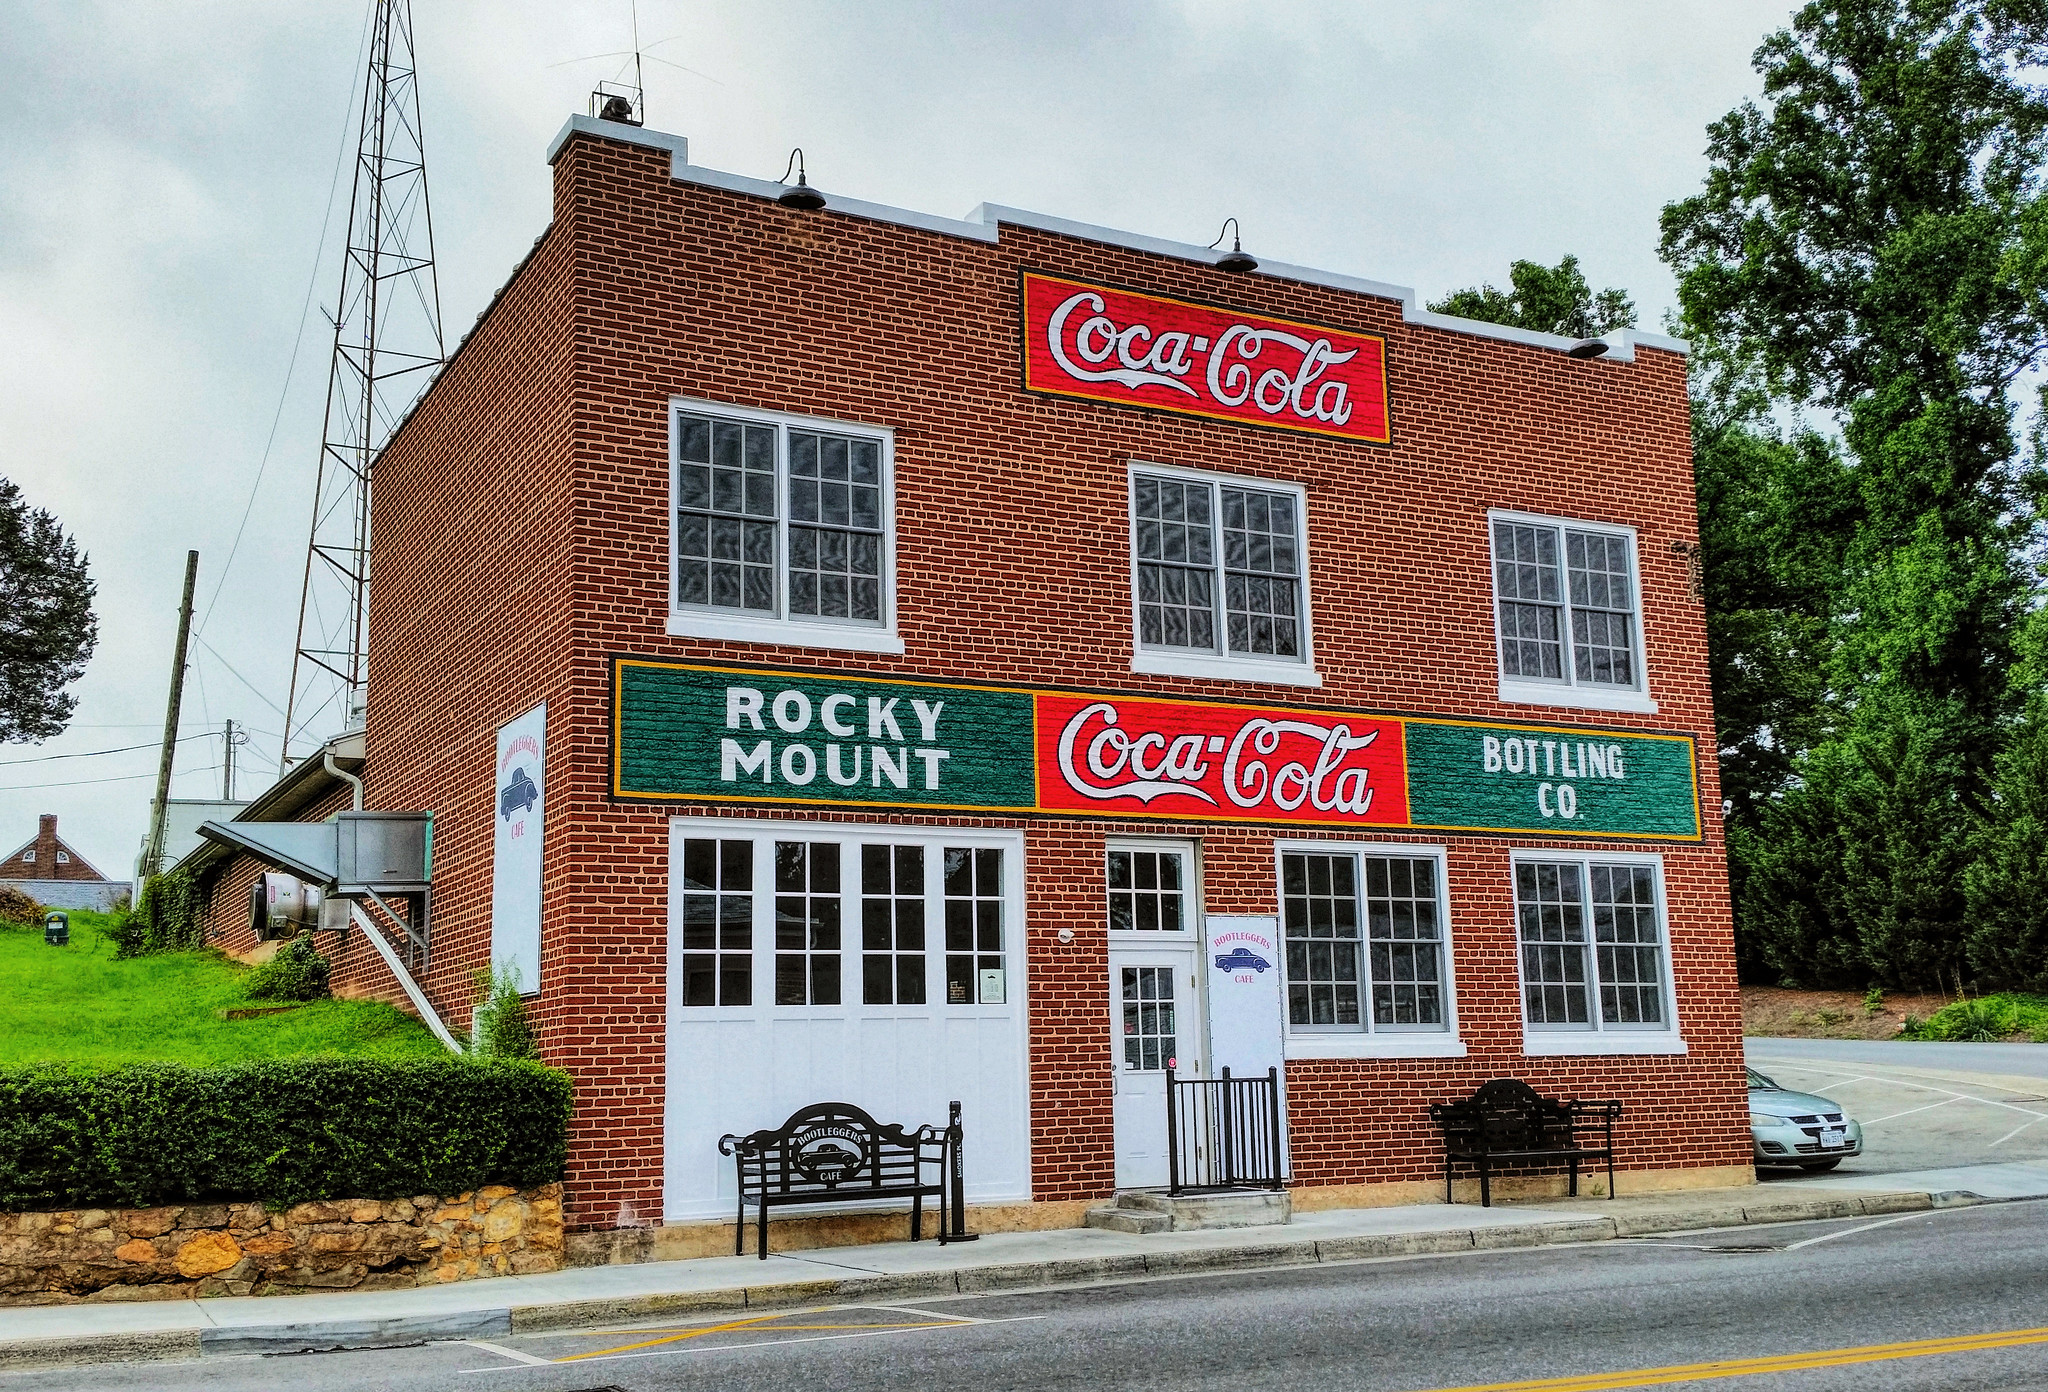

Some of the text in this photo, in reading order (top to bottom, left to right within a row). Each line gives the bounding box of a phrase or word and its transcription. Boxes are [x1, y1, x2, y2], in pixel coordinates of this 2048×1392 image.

[1047, 291, 1360, 427] Coca-Cola
[726, 686, 945, 742] ROCKY
[720, 738, 950, 791] MOUNT
[1057, 702, 1380, 816] Coca-Cola
[1482, 735, 1625, 780] BOTTLING
[1537, 782, 1585, 819] CO.
[1213, 931, 1272, 950] BOOTLEGGERS
[797, 1126, 863, 1146] BOOTLEGGERS
